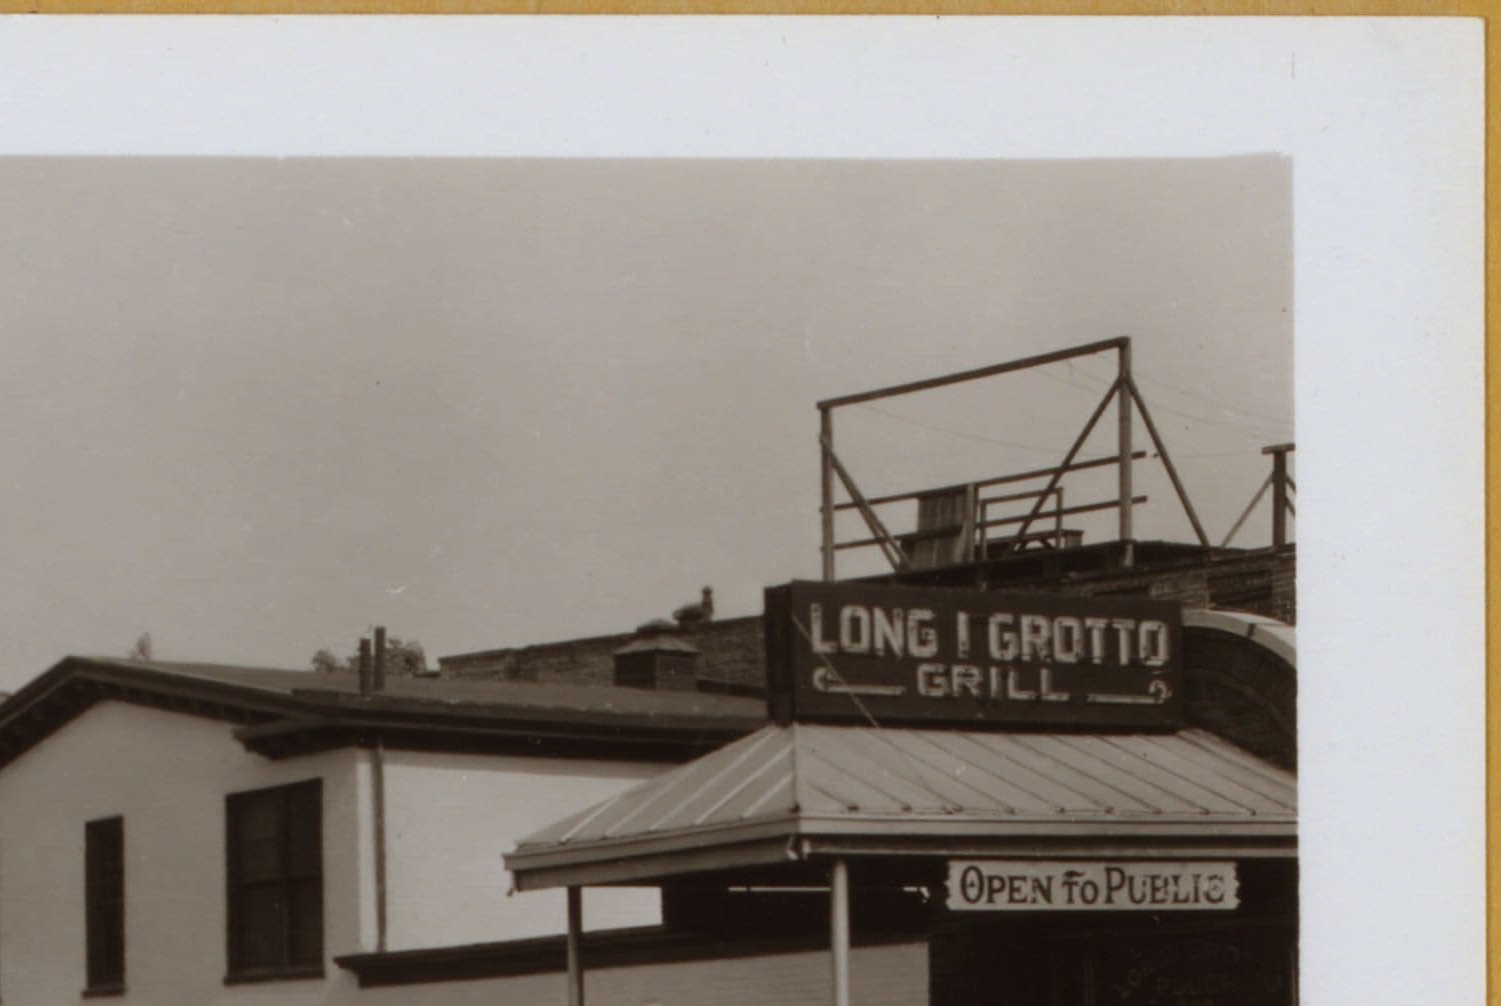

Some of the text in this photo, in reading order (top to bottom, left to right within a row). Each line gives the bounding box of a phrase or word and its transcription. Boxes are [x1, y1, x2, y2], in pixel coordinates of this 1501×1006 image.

[810, 603, 938, 660] LONG
[988, 612, 1171, 667] GROTTO
[916, 663, 1071, 702] GRILL
[959, 865, 1054, 905] OPEN
